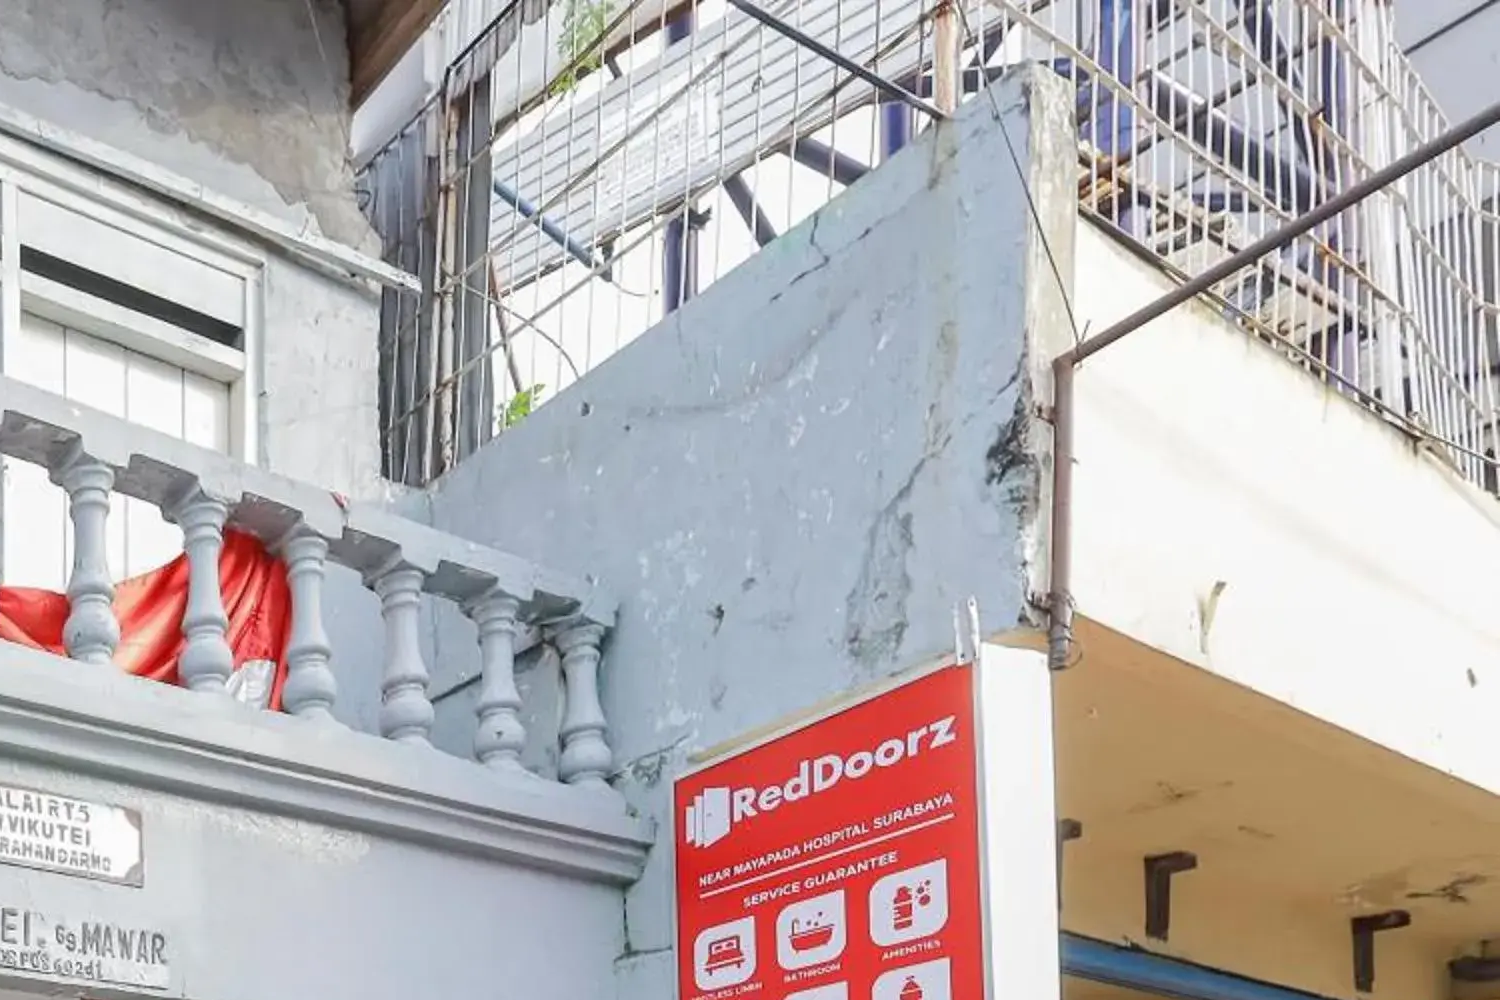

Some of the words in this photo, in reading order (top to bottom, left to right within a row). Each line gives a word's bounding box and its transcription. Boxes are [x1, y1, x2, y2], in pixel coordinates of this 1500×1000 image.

[733, 715, 956, 823] RedDoorz
[699, 868, 731, 888] NEAR
[733, 845, 801, 877] MAYAPADA
[803, 824, 869, 853] HOSPITAL
[873, 792, 954, 830] SURABAYA
[743, 882, 800, 908] SERVICE
[803, 851, 899, 889] GUARANTEE
[783, 962, 841, 983] BATHROOM
[881, 939, 941, 961] AMENITIES
